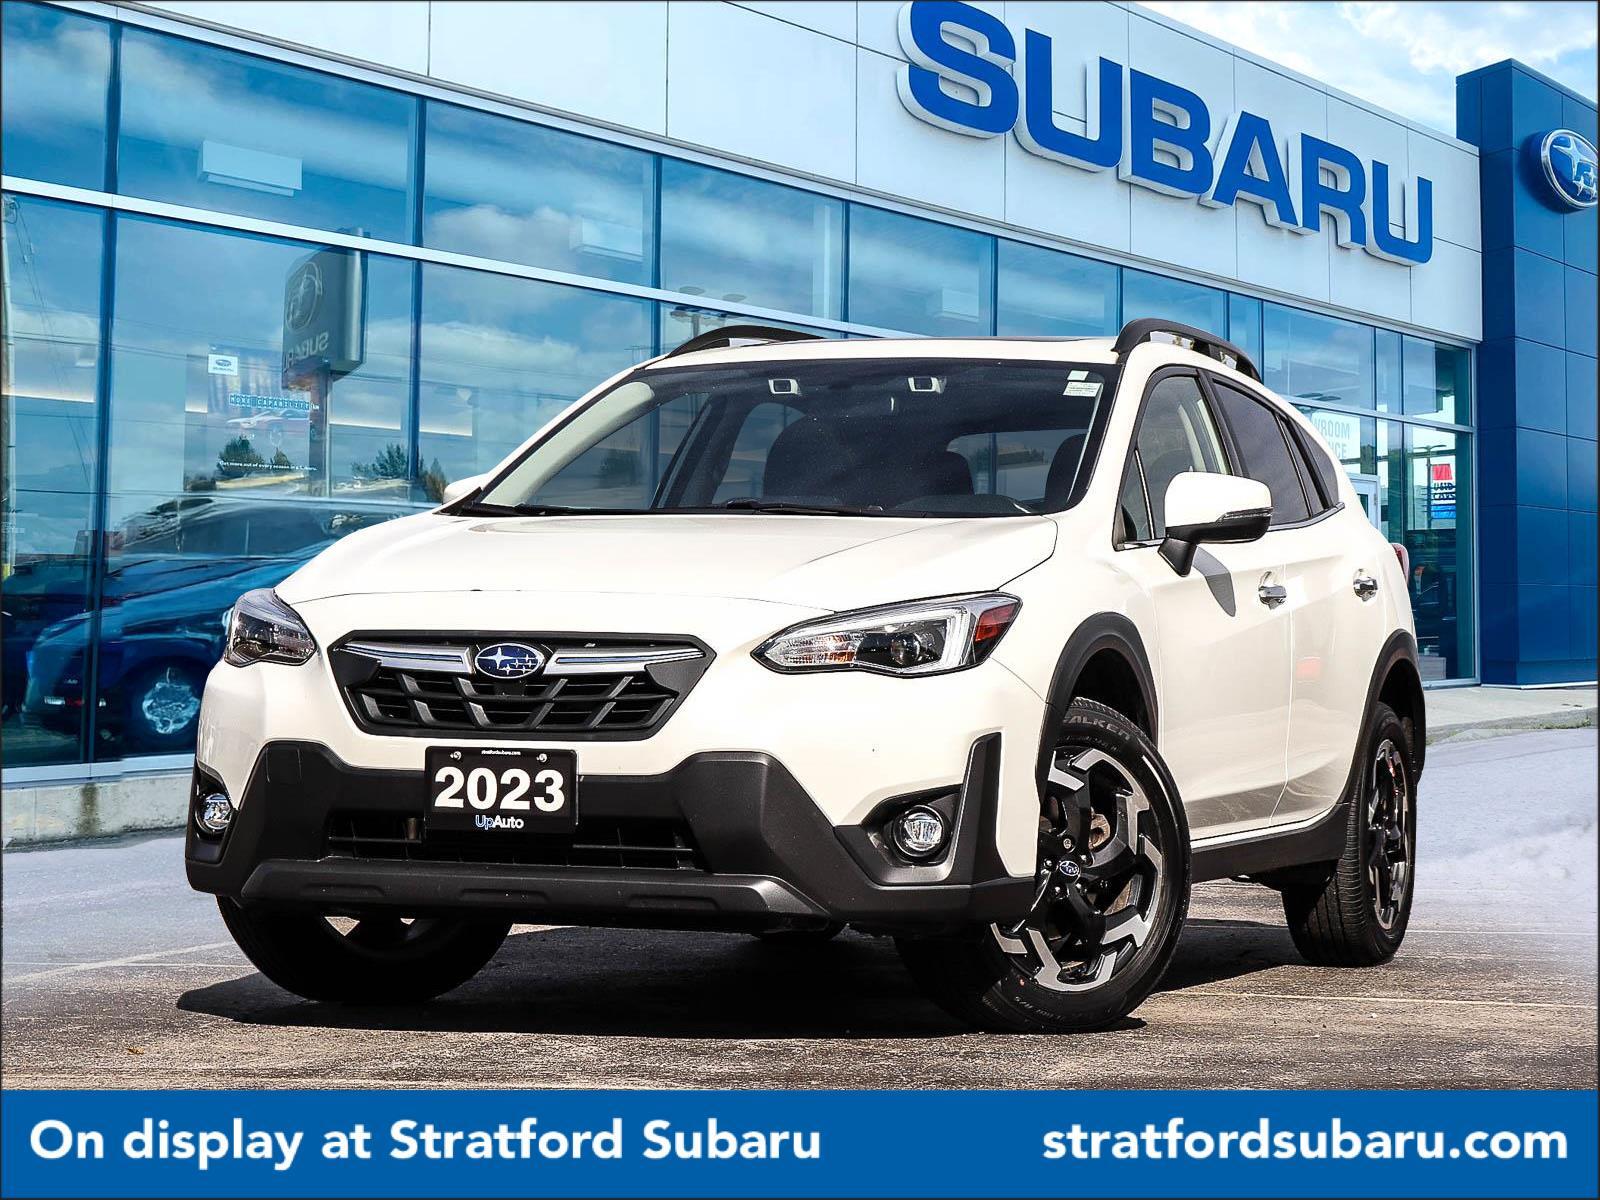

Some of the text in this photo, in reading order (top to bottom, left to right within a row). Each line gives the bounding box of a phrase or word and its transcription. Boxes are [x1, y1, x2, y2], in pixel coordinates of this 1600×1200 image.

[904, 1, 1433, 265] SUBARU
[434, 766, 566, 812] 2023
[475, 814, 525, 831] UpAuto
